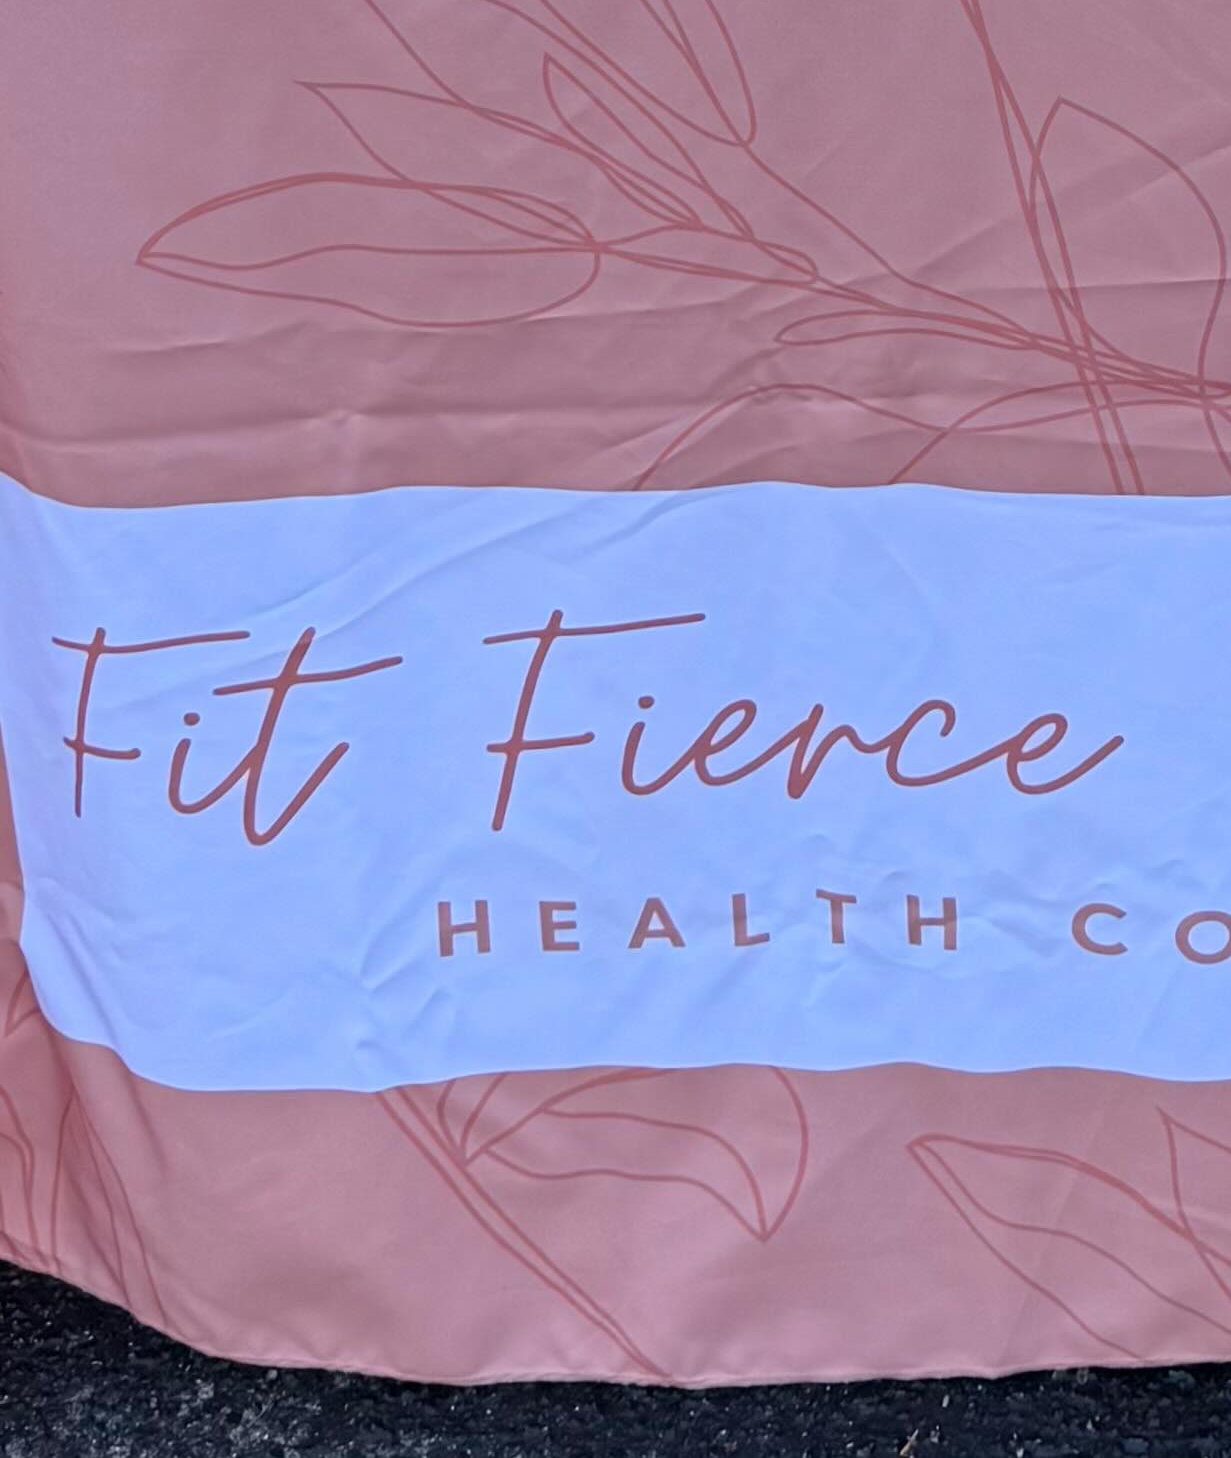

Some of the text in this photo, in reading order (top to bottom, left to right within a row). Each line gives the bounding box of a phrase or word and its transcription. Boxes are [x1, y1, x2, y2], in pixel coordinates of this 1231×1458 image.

[50, 624, 404, 847] Fit
[482, 607, 1126, 832] Fierce
[436, 888, 961, 959] HEALTH
